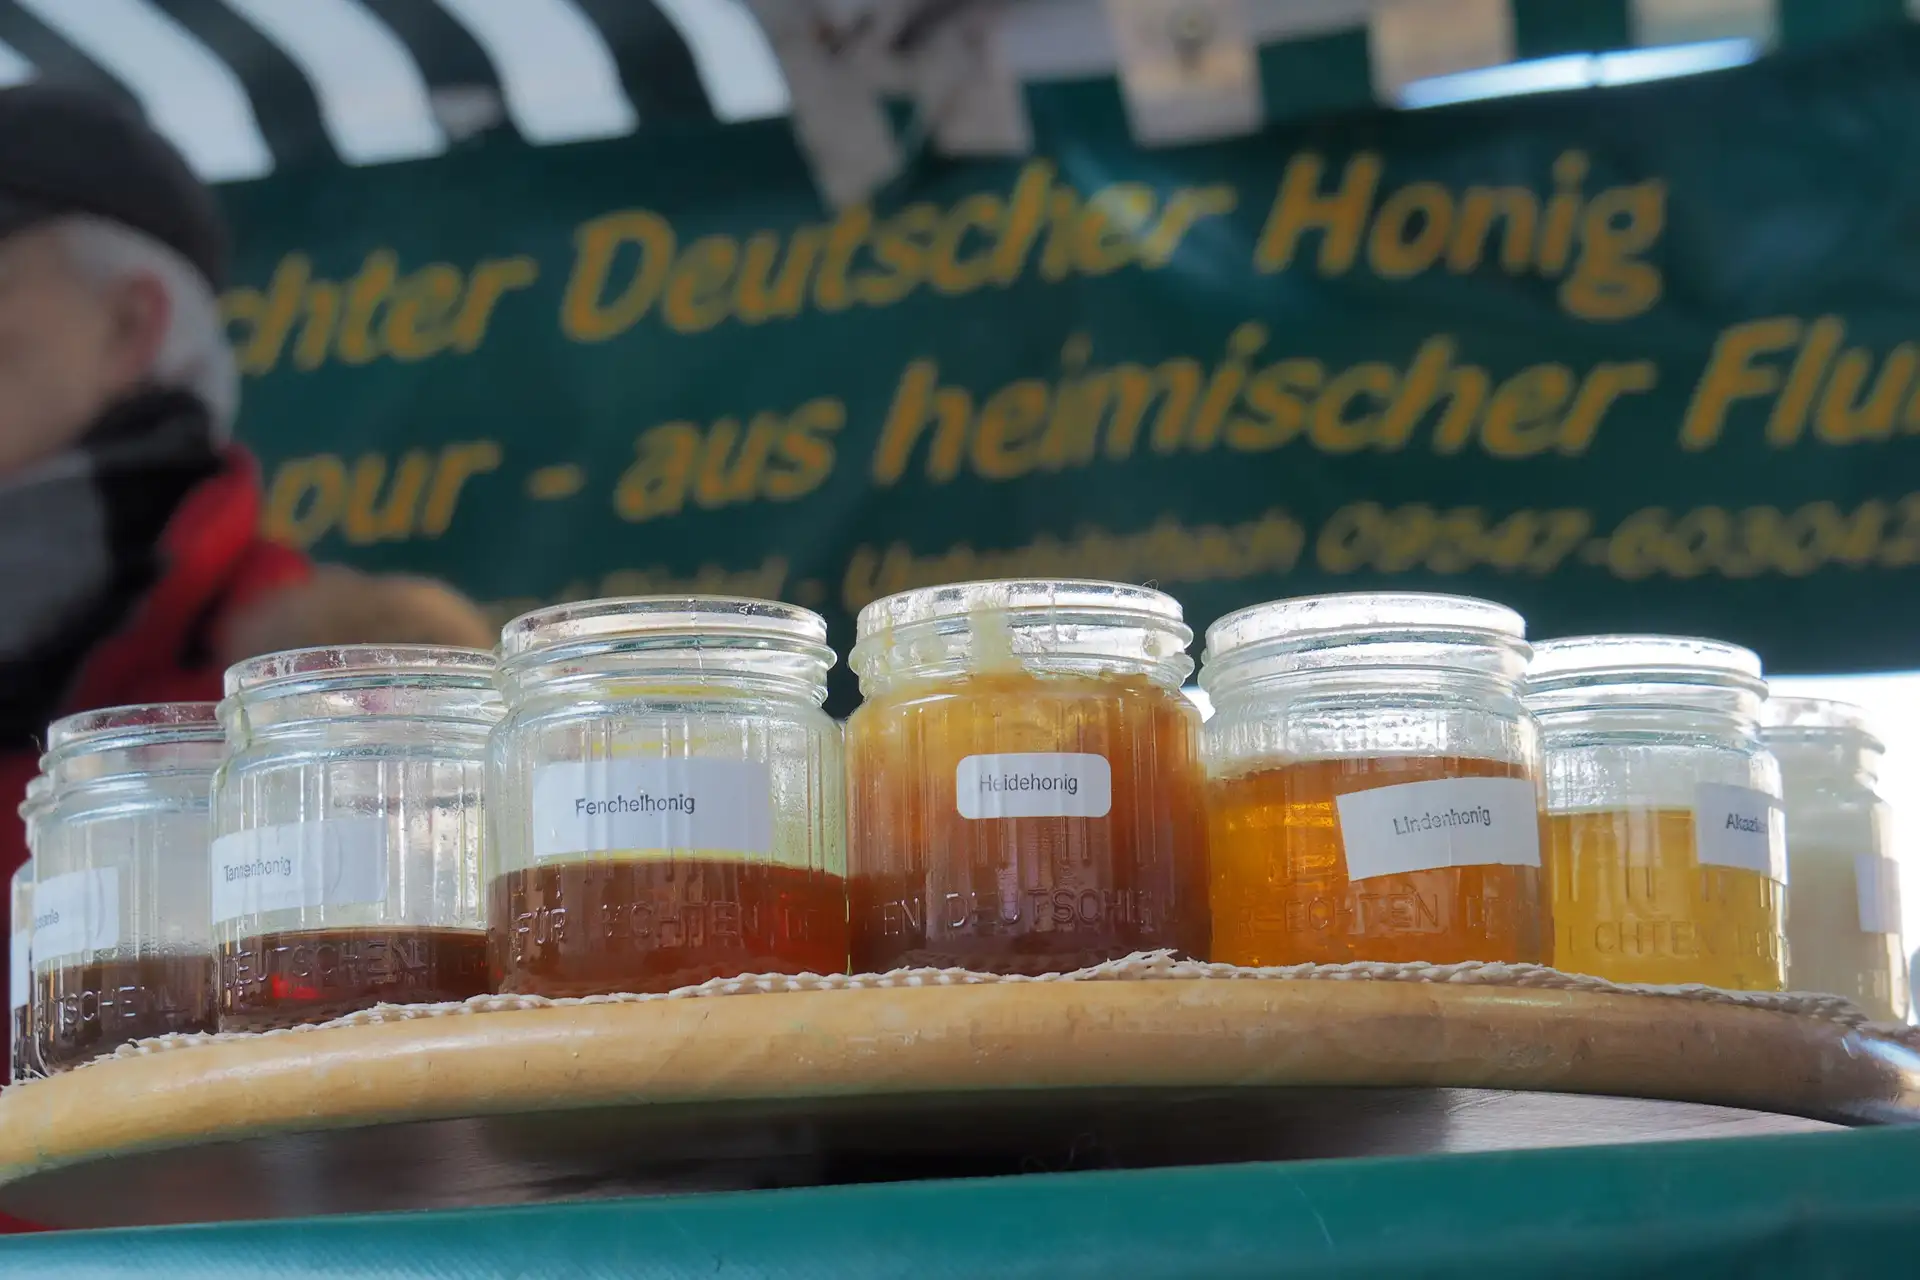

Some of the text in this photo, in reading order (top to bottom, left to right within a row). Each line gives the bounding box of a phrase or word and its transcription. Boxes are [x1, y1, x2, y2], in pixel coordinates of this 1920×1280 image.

[217, 149, 1666, 376] chter Deutscher Honig
[615, 398, 845, 522] aus
[872, 321, 1656, 484] heimischer
[1678, 314, 1920, 451] Flu
[980, 773, 1078, 795] Heidehonig
[575, 793, 696, 818] Fenchelhonig
[1393, 805, 1491, 835] Lindenhonig
[223, 856, 291, 882] Tannenhonig
[1567, 920, 1719, 956] CHTEN
